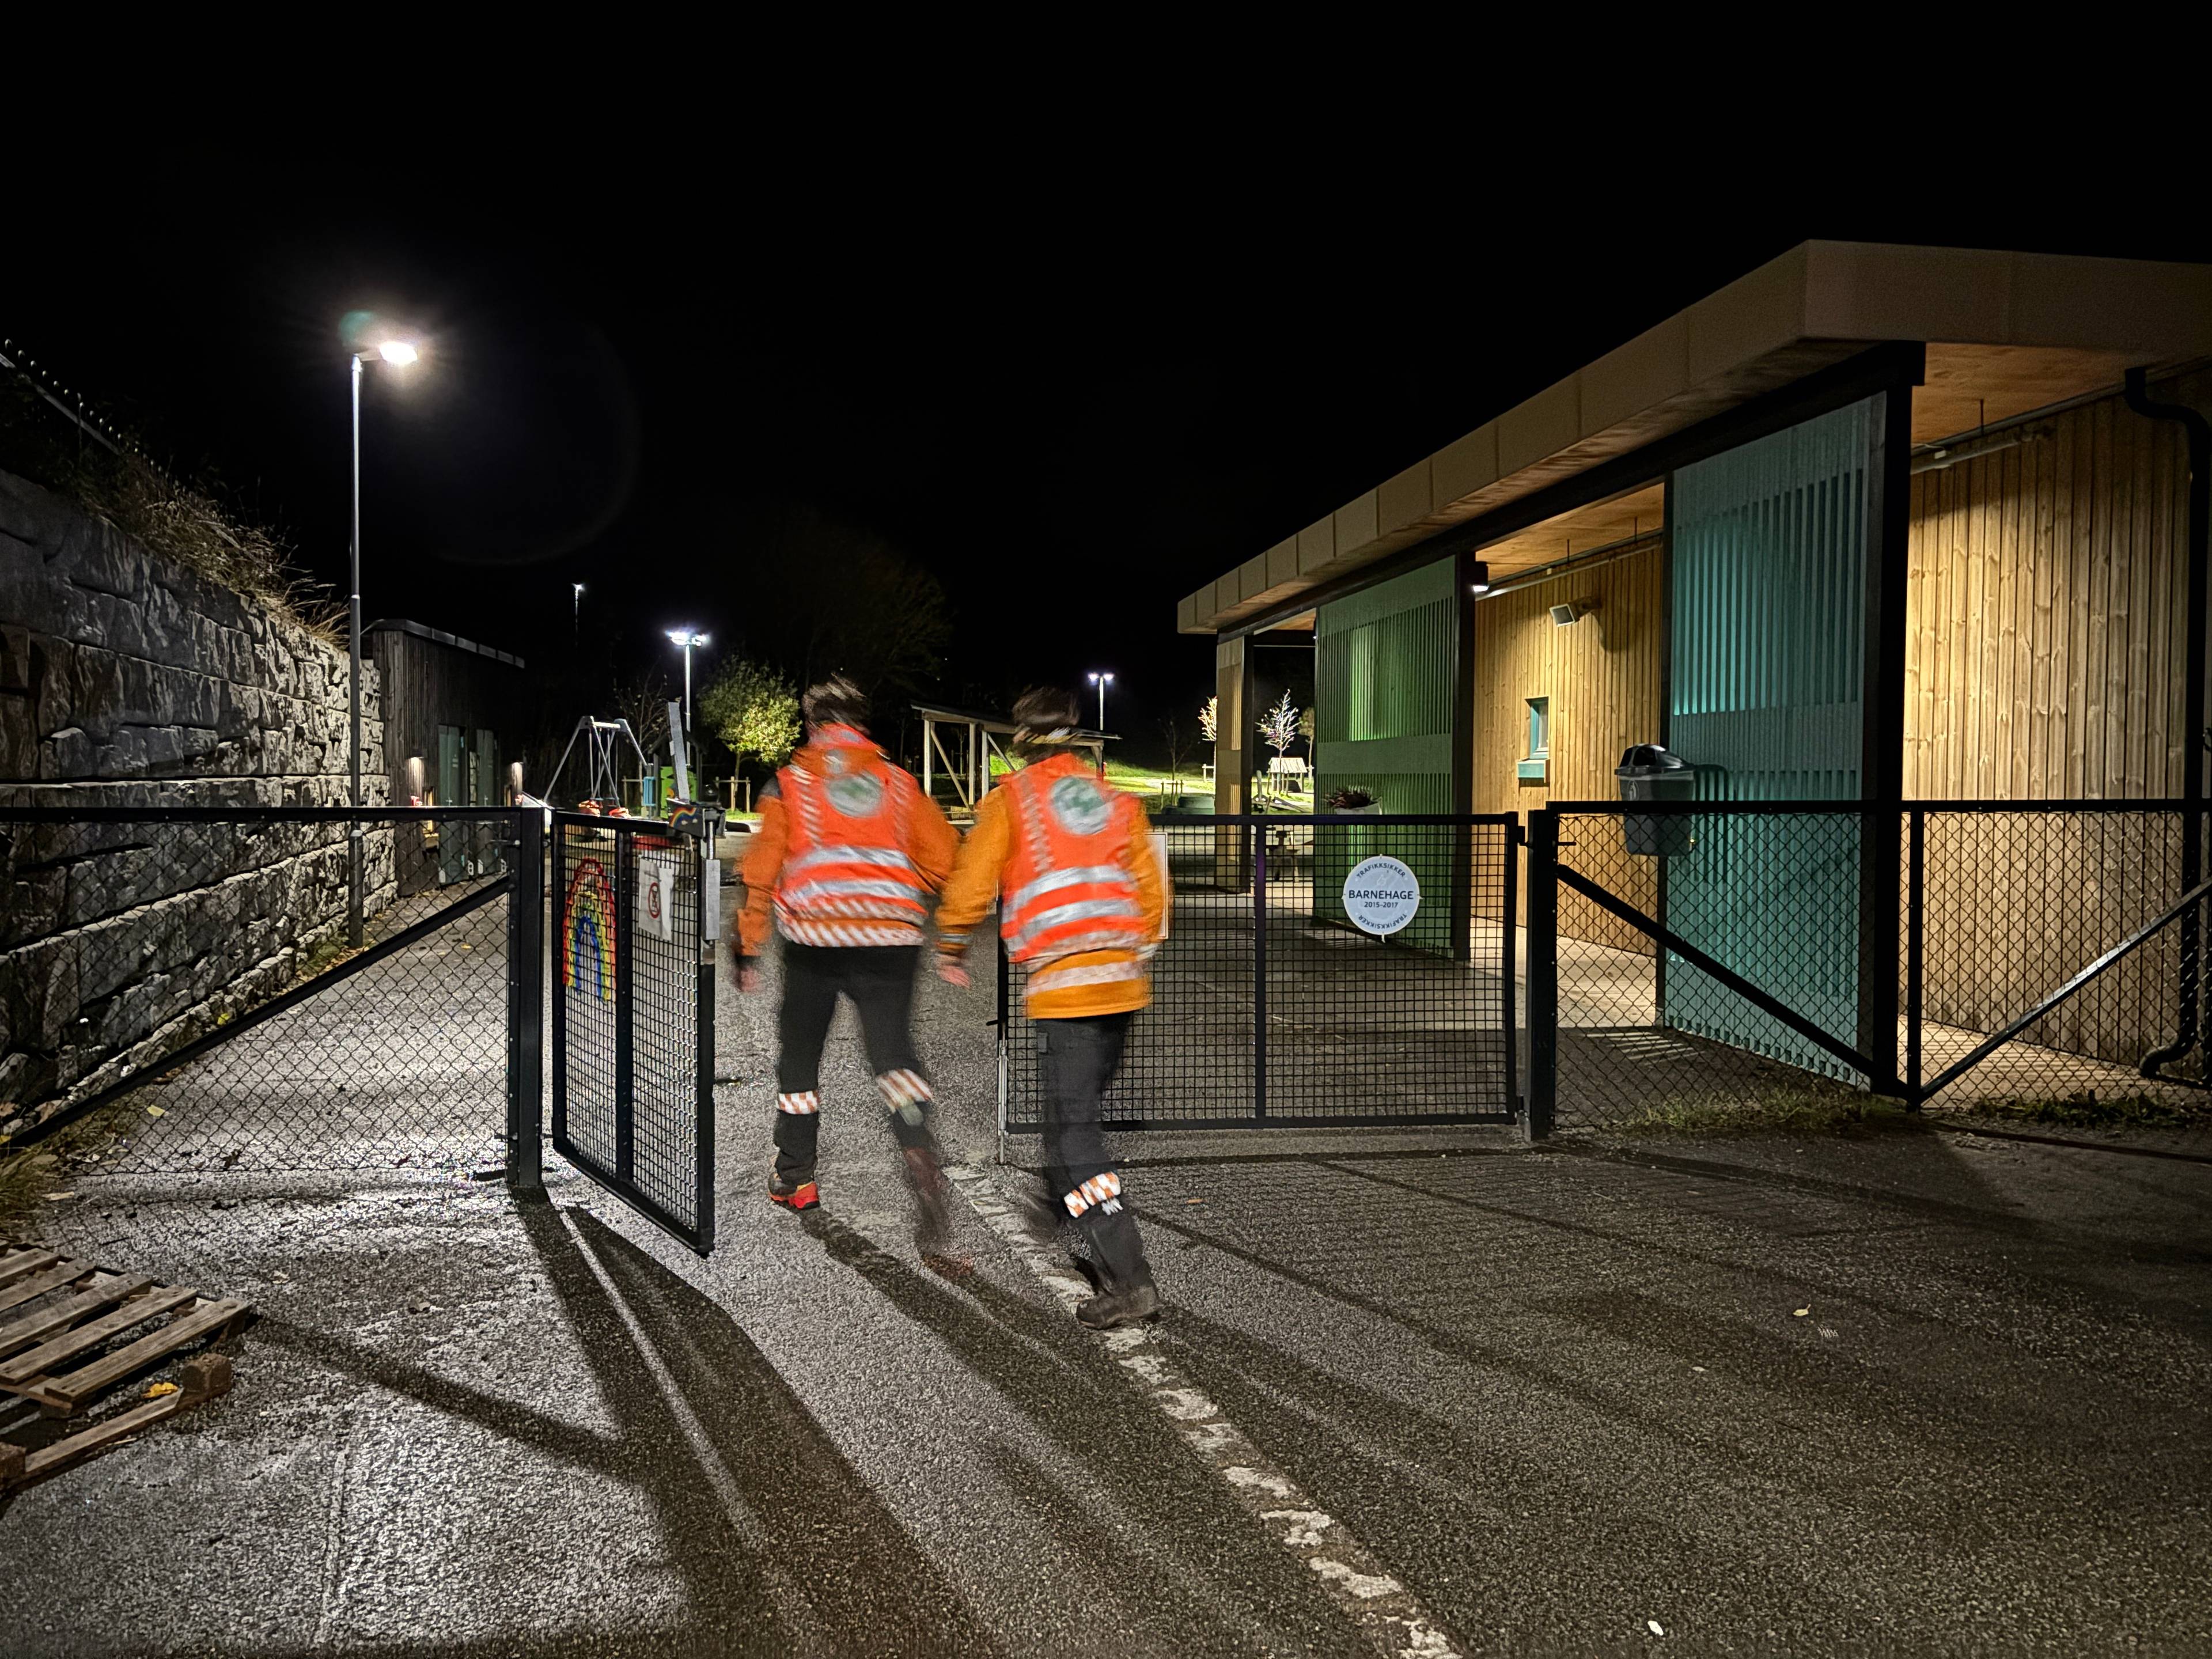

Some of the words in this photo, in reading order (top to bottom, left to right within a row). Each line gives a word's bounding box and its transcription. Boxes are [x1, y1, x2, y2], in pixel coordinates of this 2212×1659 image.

[1356, 862, 1406, 878] TRAFIKKSIKKER
[1349, 890, 1414, 900] BARNEHAGE
[1358, 914, 1407, 929] TRAFIKKSIKKER
